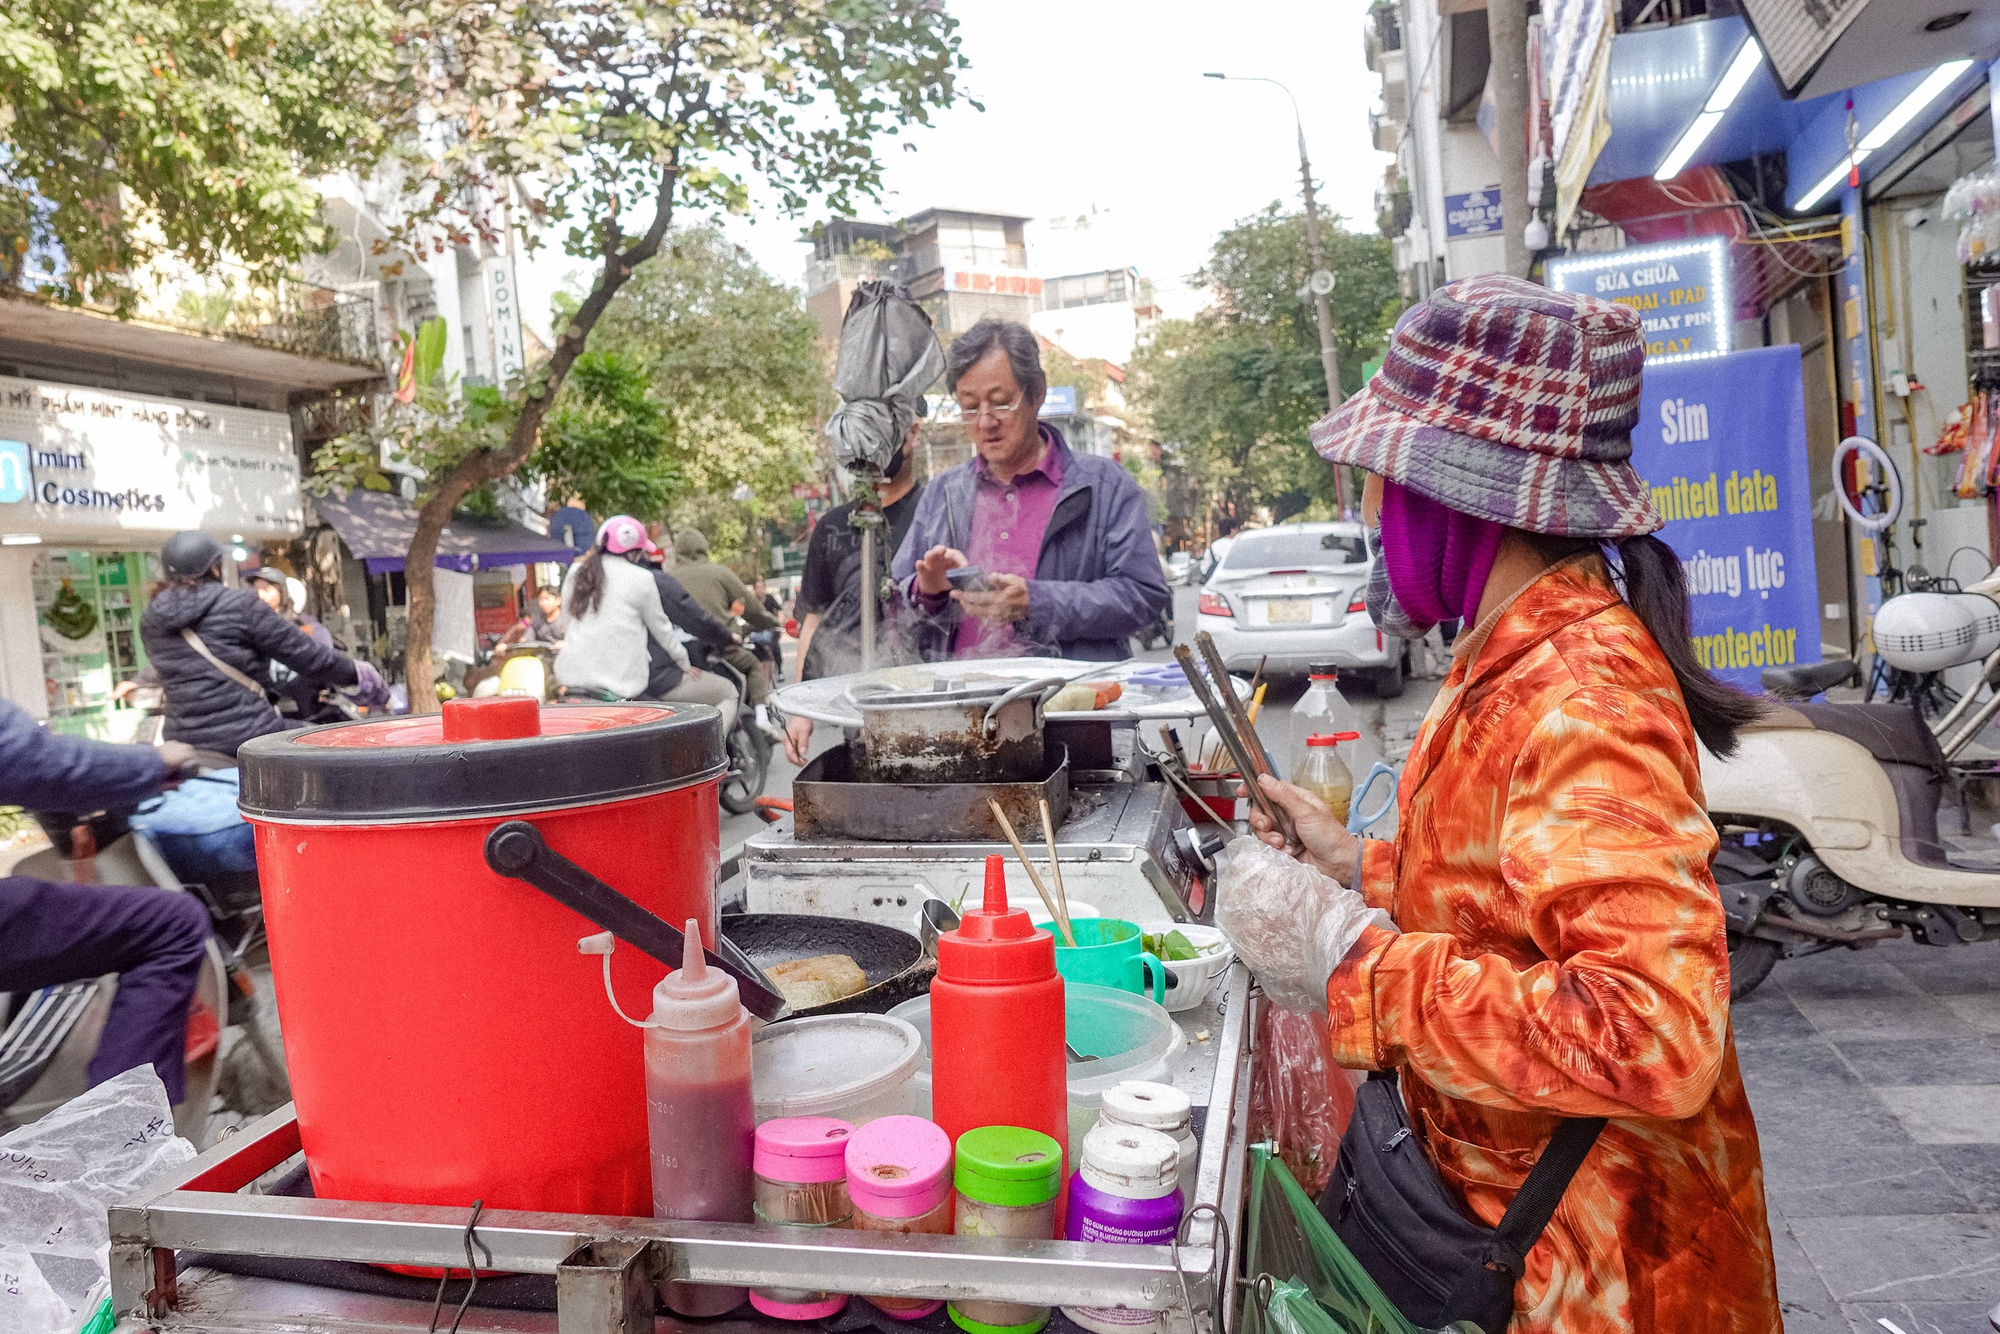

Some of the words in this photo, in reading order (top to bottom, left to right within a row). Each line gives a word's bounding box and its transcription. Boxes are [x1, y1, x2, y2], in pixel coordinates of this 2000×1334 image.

[1669, 285, 1707, 307] IPAD
[1683, 311, 1713, 328] PIN
[1661, 398, 1709, 445] Sim
[38, 448, 85, 469] mint
[42, 481, 165, 513] Cosmetics
[1725, 469, 1779, 515] data
[1746, 545, 1786, 600] lực
[657, 1101, 676, 1116] 200
[661, 1153, 679, 1169] 150
